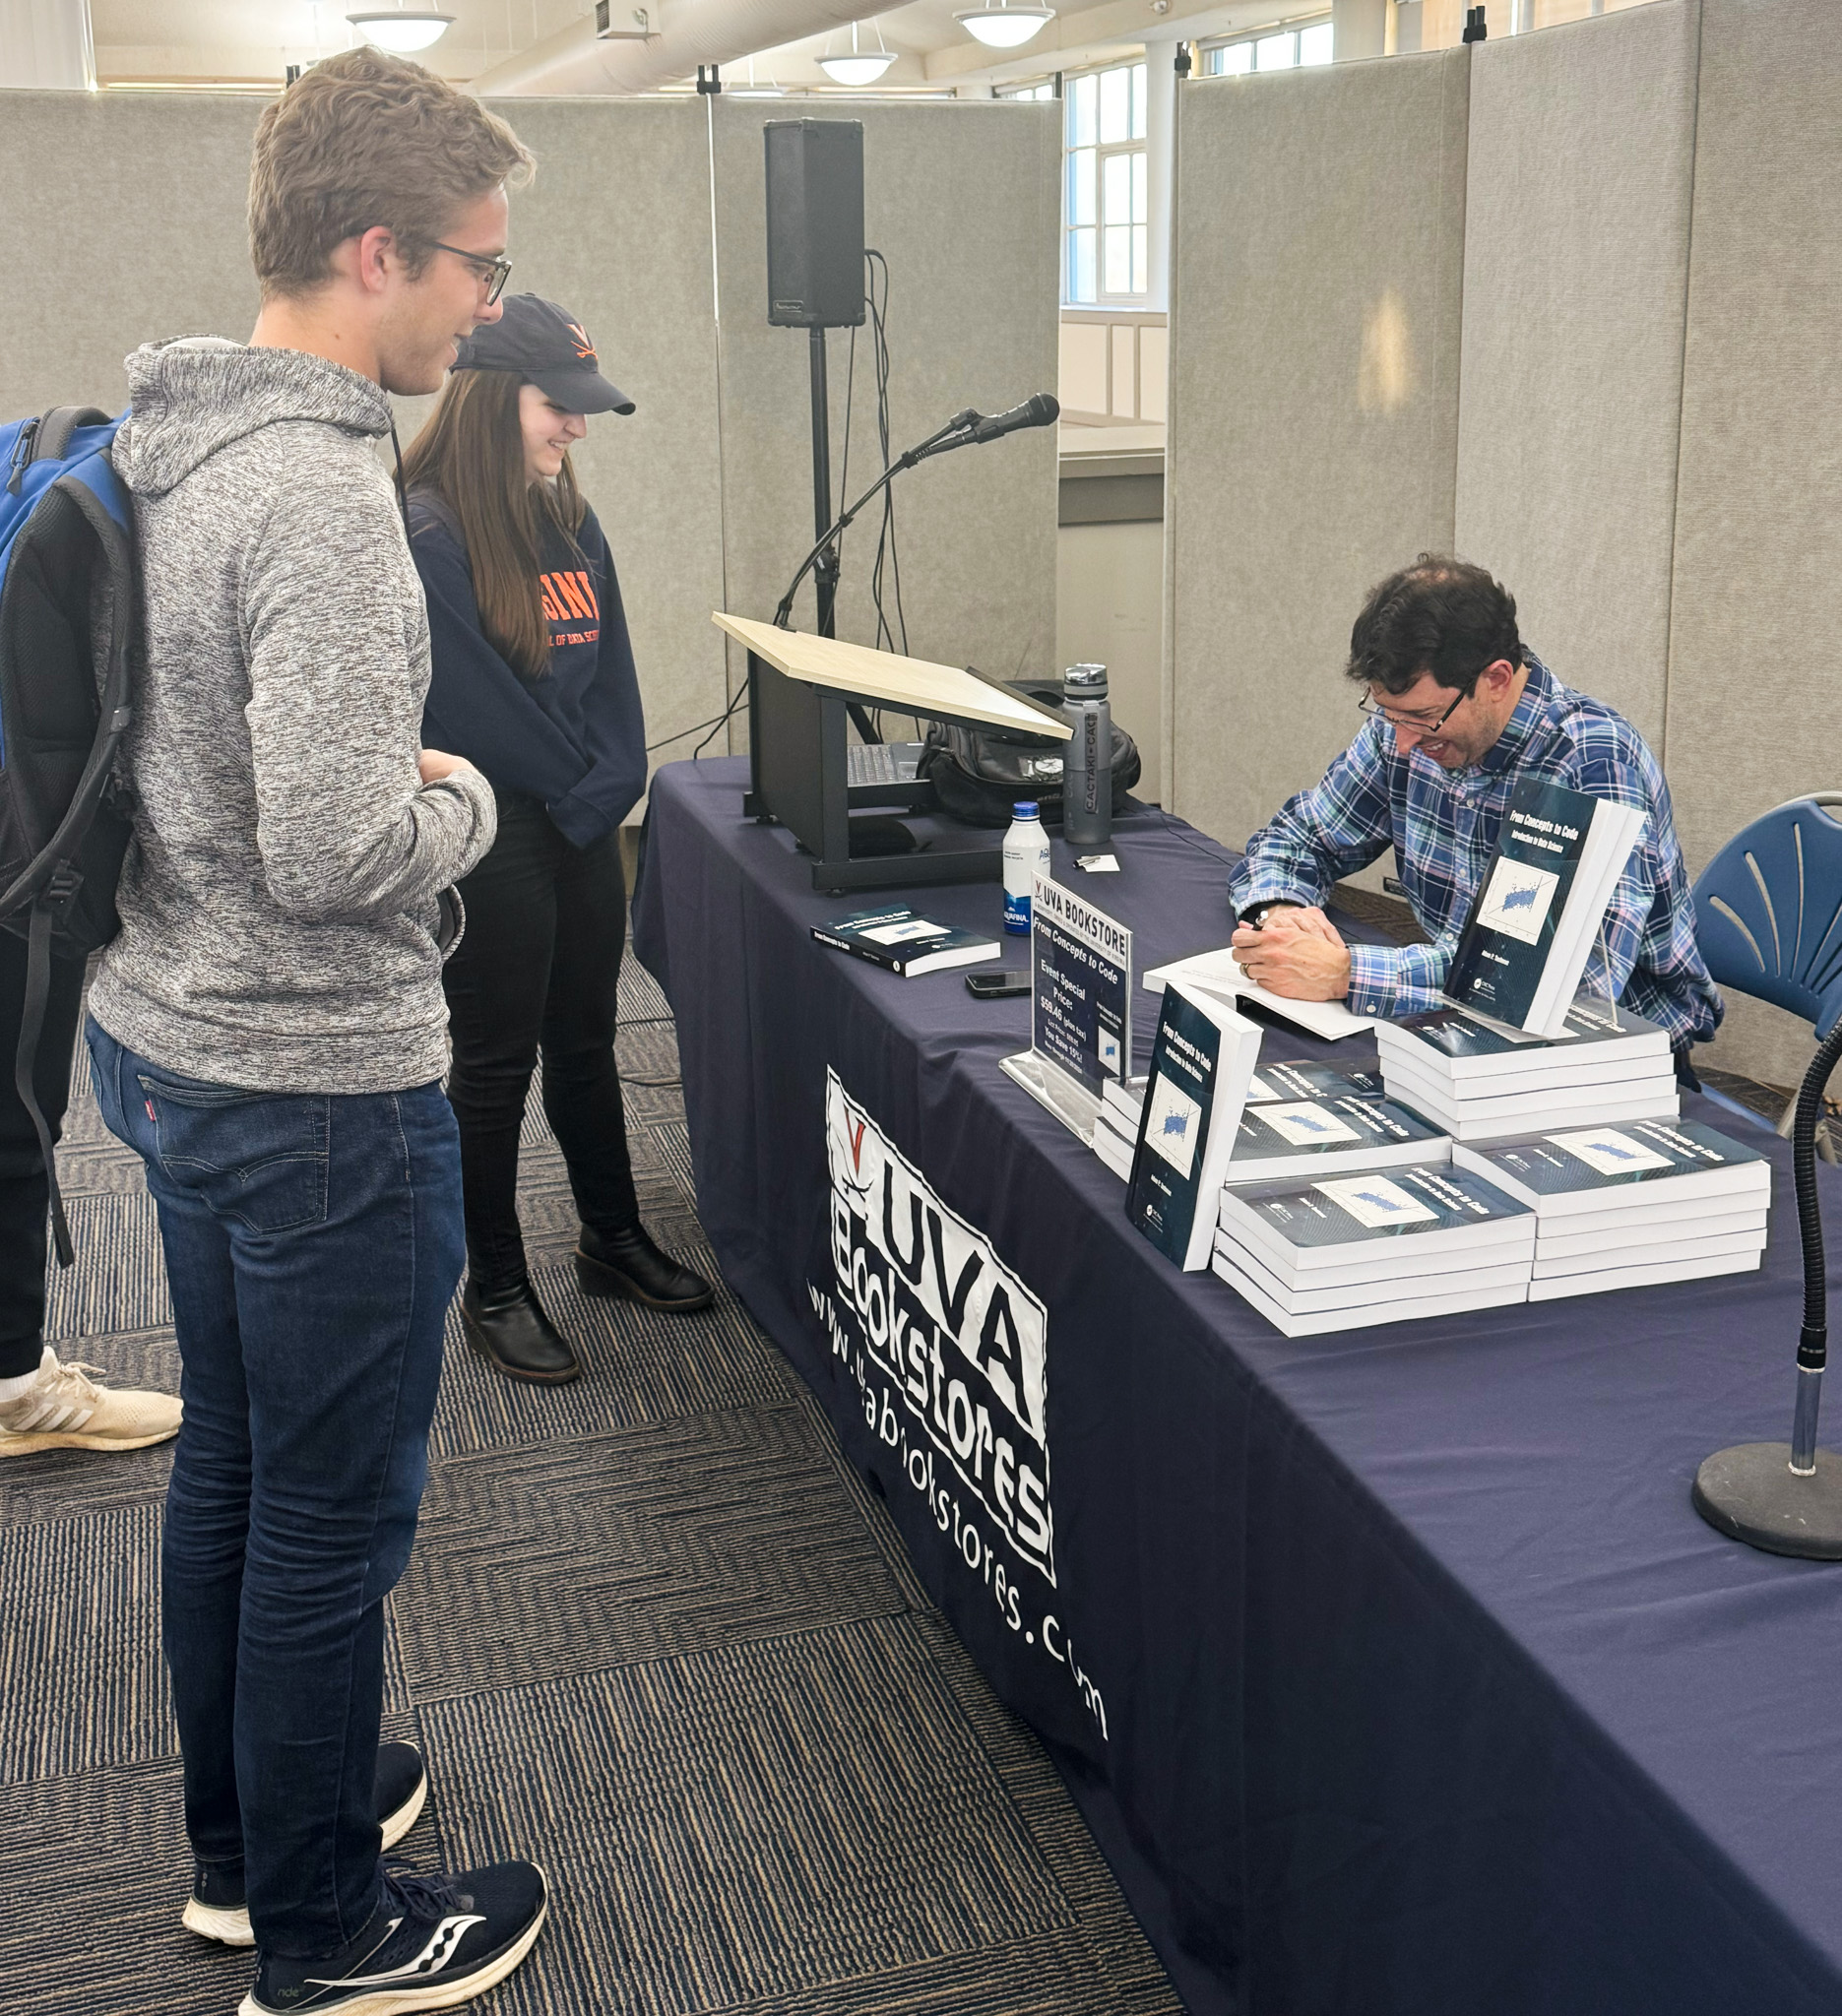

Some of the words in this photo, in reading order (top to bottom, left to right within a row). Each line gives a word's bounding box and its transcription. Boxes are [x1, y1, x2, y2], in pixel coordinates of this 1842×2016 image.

[555, 634, 566, 646] OF
[566, 633, 586, 645] DATA
[1509, 809, 1525, 825] From
[1523, 813, 1554, 833] Concepts
[1554, 823, 1561, 836] to
[1561, 825, 1579, 841] Code
[1044, 885, 1063, 915] UVA
[1065, 898, 1125, 957] BOOKSTORE
[1034, 916, 1051, 938] From
[1052, 930, 1087, 963] Concepts
[1088, 955, 1097, 970] to
[1099, 962, 1118, 984] Code
[1041, 959, 1059, 982] Event
[1060, 973, 1086, 1001] Special
[1053, 986, 1073, 1011] Price:
[1041, 996, 1062, 1021] $59.46
[1045, 1026, 1054, 1041] You
[1055, 1035, 1068, 1052] Save
[1163, 1021, 1175, 1040] From
[1174, 1031, 1195, 1057] Concepts
[1200, 1052, 1212, 1072] Code
[1356, 1102, 1386, 1120] Concepts
[1389, 1124, 1410, 1137] Code
[1657, 1126, 1695, 1146] Concepts
[1700, 1149, 1725, 1162] Code
[1410, 1166, 1433, 1177] From
[1428, 1175, 1464, 1197] Concepts
[1467, 1201, 1490, 1215] Code
[883, 1159, 1035, 1435] UVA
[832, 1187, 1050, 1555] Bookstores
